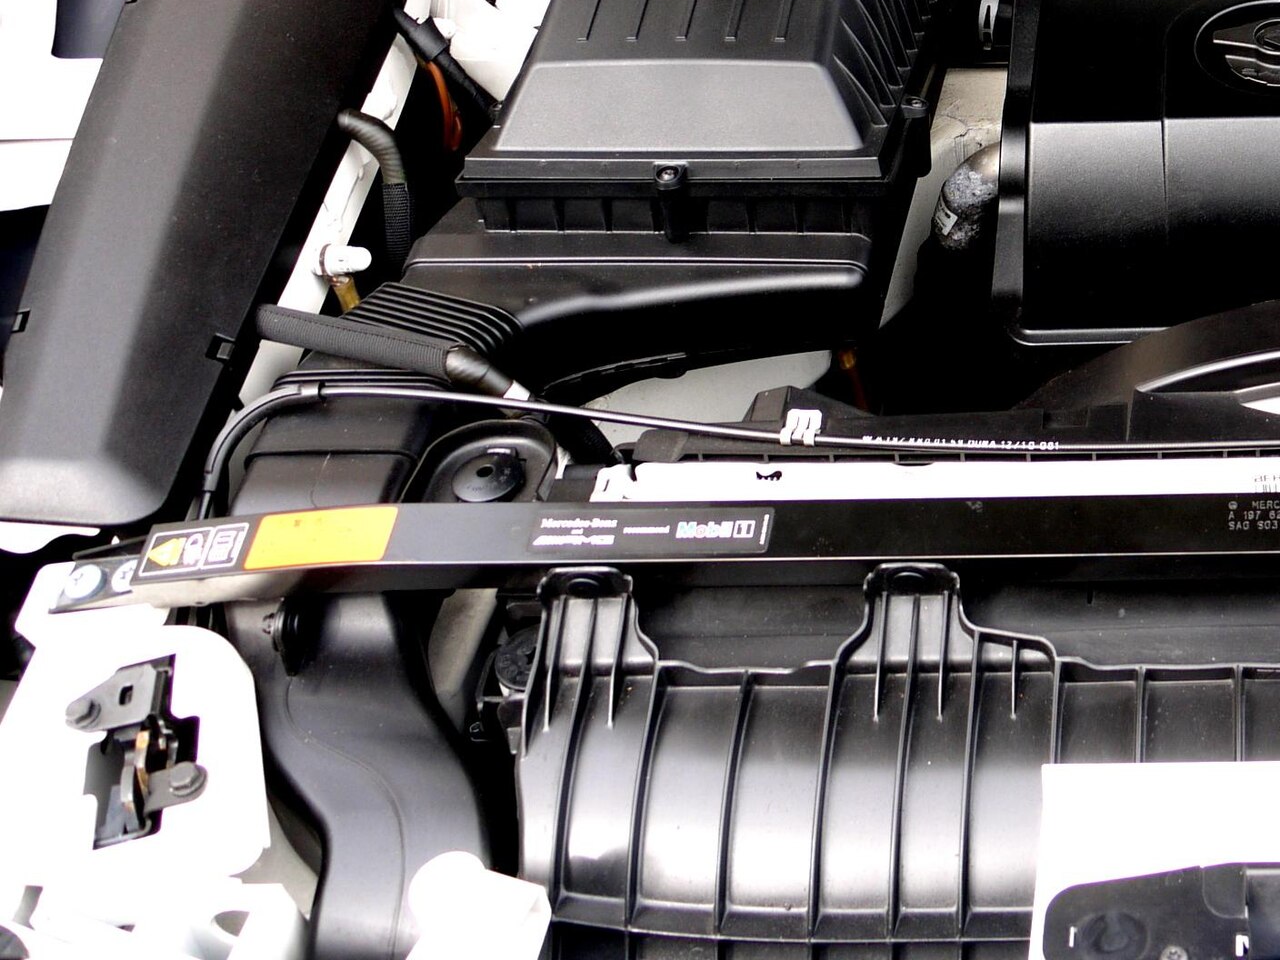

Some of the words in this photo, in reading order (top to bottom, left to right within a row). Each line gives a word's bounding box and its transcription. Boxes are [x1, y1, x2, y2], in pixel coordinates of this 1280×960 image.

[1228, 511, 1236, 520] A
[1243, 510, 1261, 520] 197
[676, 521, 733, 539] Mobil
